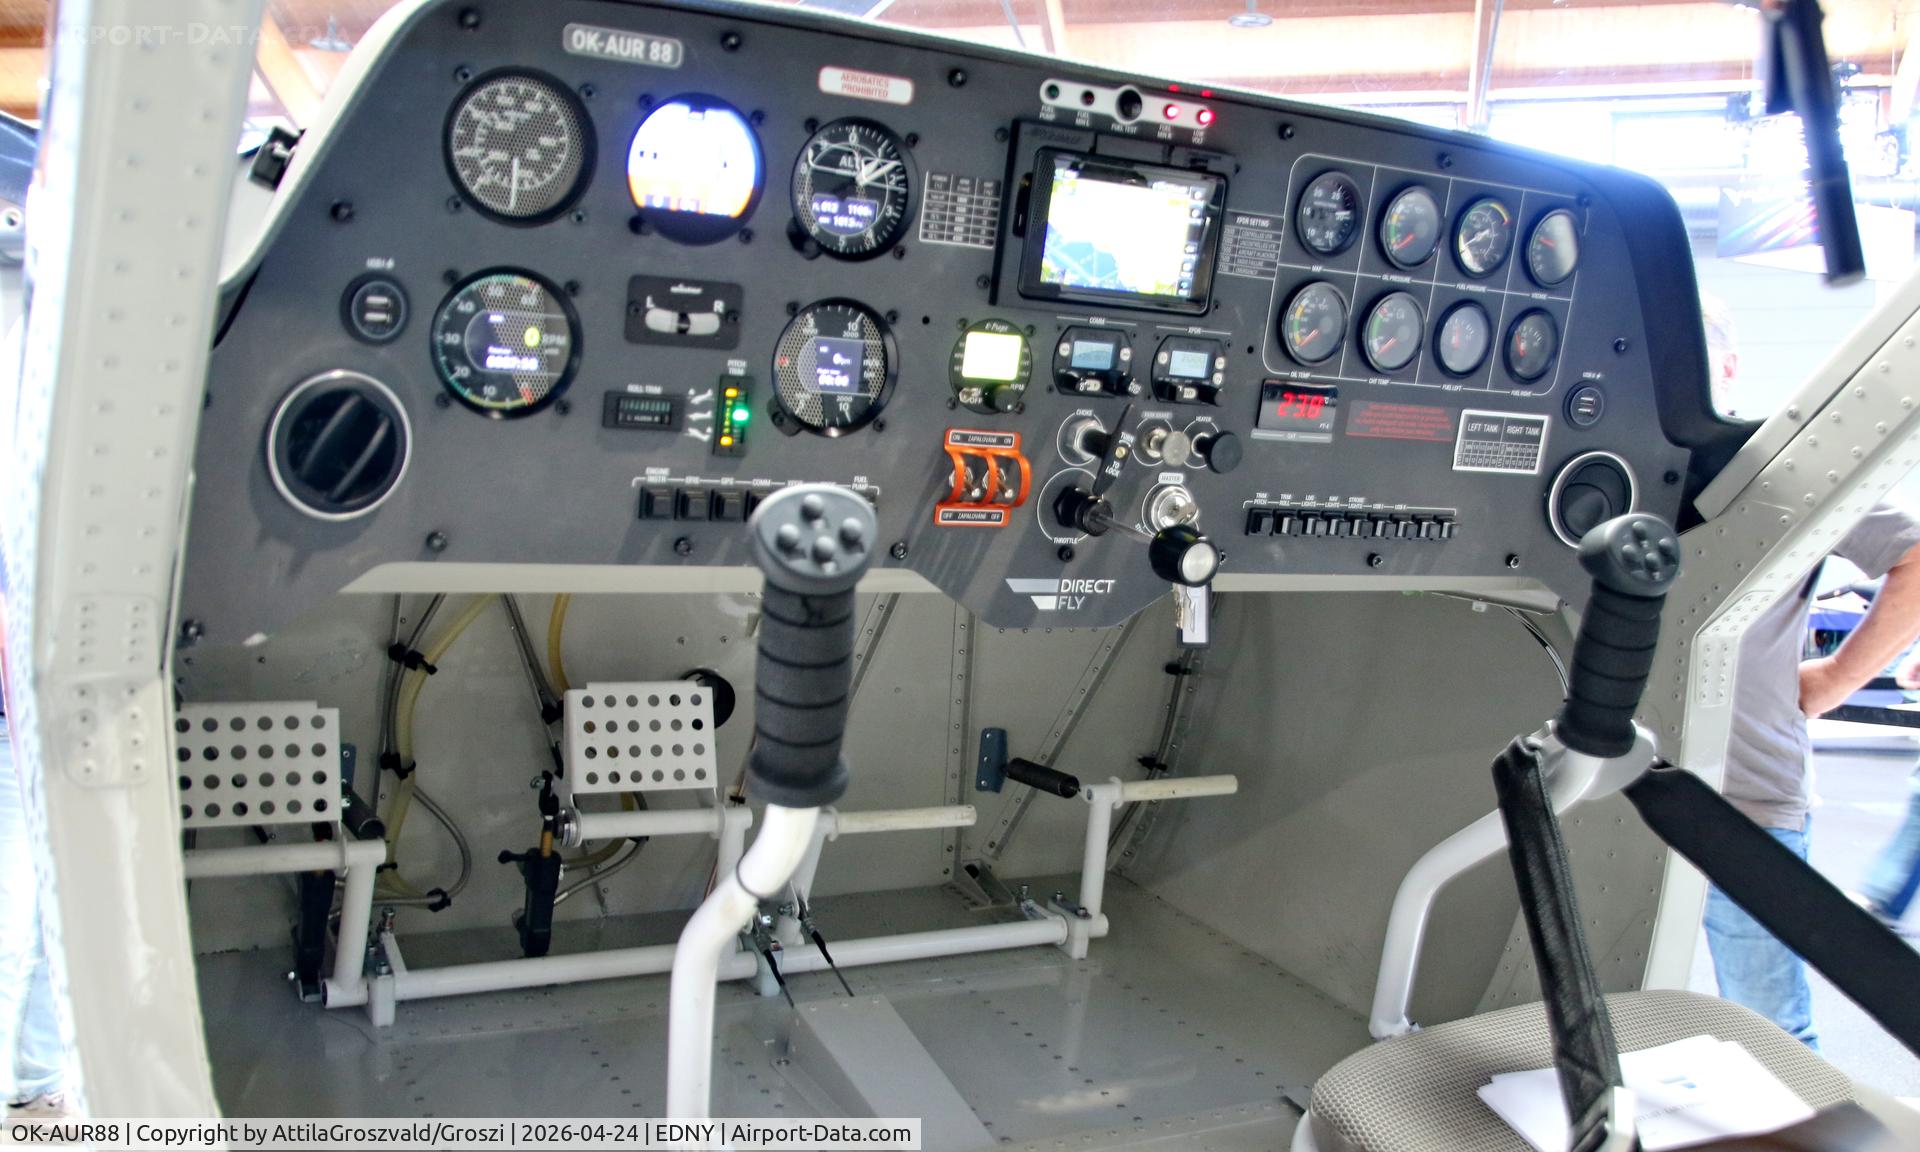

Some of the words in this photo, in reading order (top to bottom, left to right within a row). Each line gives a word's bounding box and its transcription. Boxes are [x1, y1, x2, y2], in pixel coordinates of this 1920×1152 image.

[572, 29, 645, 59] OK-AUR
[649, 41, 672, 63] 88
[841, 72, 889, 88] AEROBATICS
[841, 83, 889, 97] PROHIBITED
[1125, 125, 1137, 134] TEST
[889, 174, 896, 186] 2
[885, 206, 892, 216] 3
[646, 294, 655, 308] L
[713, 300, 725, 313] R
[457, 302, 475, 312] 40
[847, 322, 858, 331] 10
[444, 333, 461, 344] 30
[454, 367, 471, 377] 20
[482, 386, 497, 395] 10
[1467, 423, 1481, 432] LEFT
[1483, 424, 1499, 433] TANK
[1506, 425, 1523, 434] RIGHT
[1525, 426, 1540, 436] TANK
[1120, 432, 1135, 443] TURN
[1112, 461, 1120, 469] TO
[1105, 466, 1121, 477] LOCK
[752, 479, 771, 487] COMM
[854, 475, 867, 483] FUEL
[1053, 537, 1078, 545] THROTTLE
[1060, 579, 1115, 593] DIRECT
[1058, 596, 1085, 610] FLY
